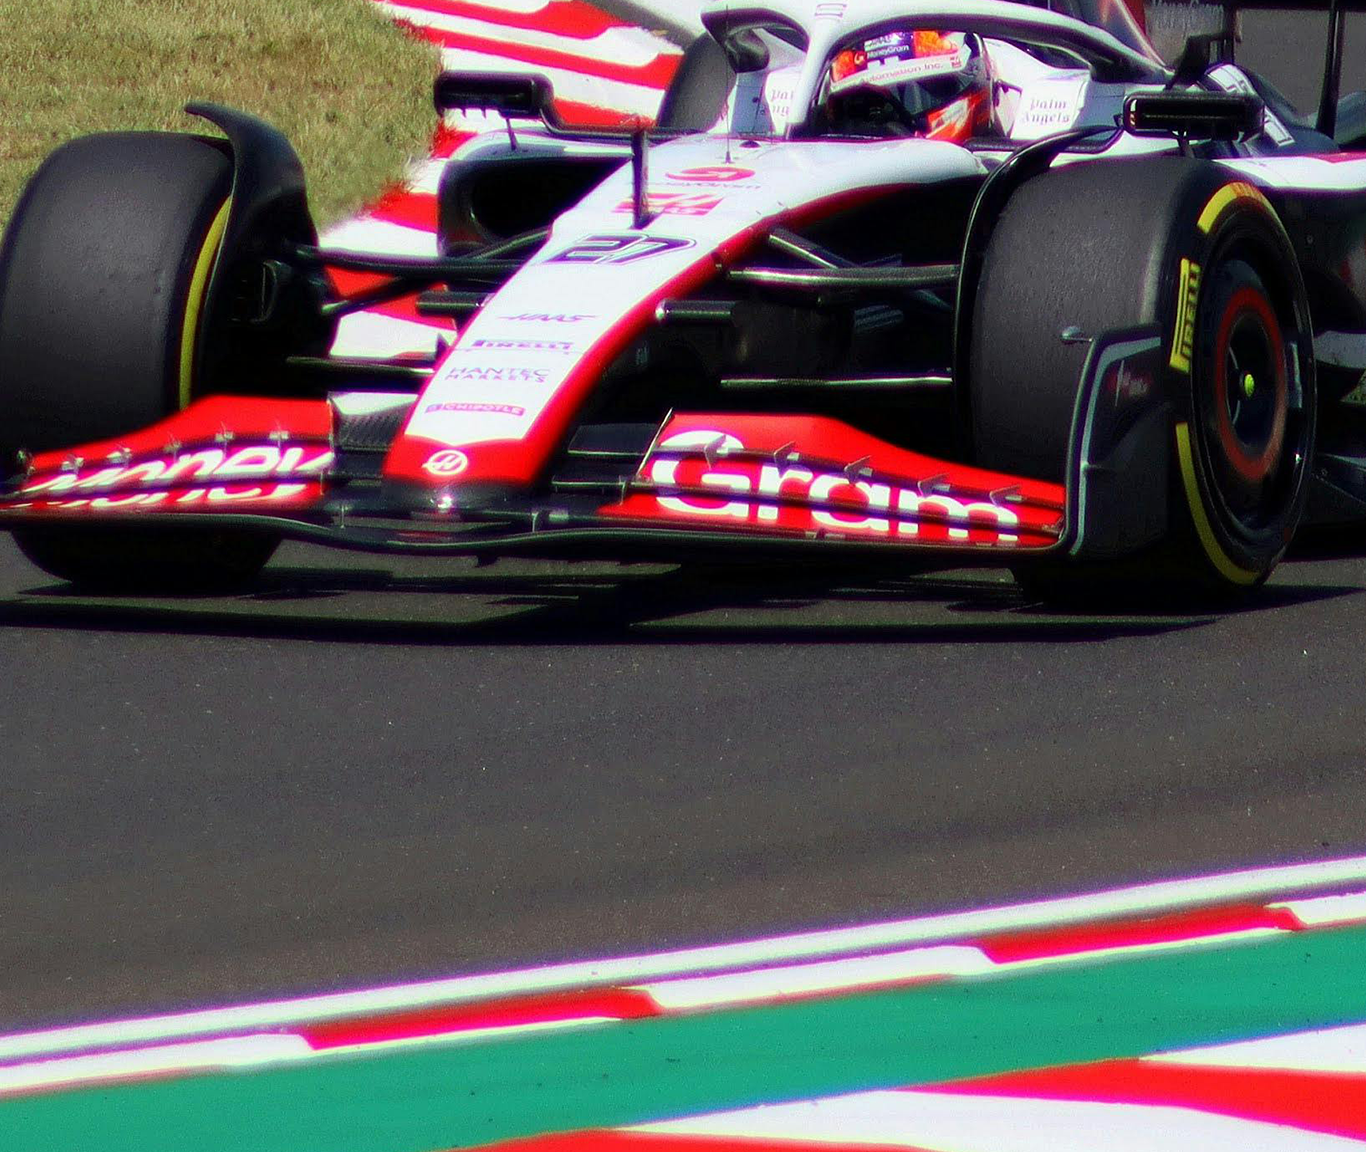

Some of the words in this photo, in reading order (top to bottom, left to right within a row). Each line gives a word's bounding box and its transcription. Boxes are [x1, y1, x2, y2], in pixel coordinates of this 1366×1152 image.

[543, 232, 697, 265] 27
[449, 367, 551, 377] HANTEC
[444, 374, 546, 384] MARKETS
[444, 403, 524, 416] CHIPOTLE
[651, 430, 1018, 541] Gram
